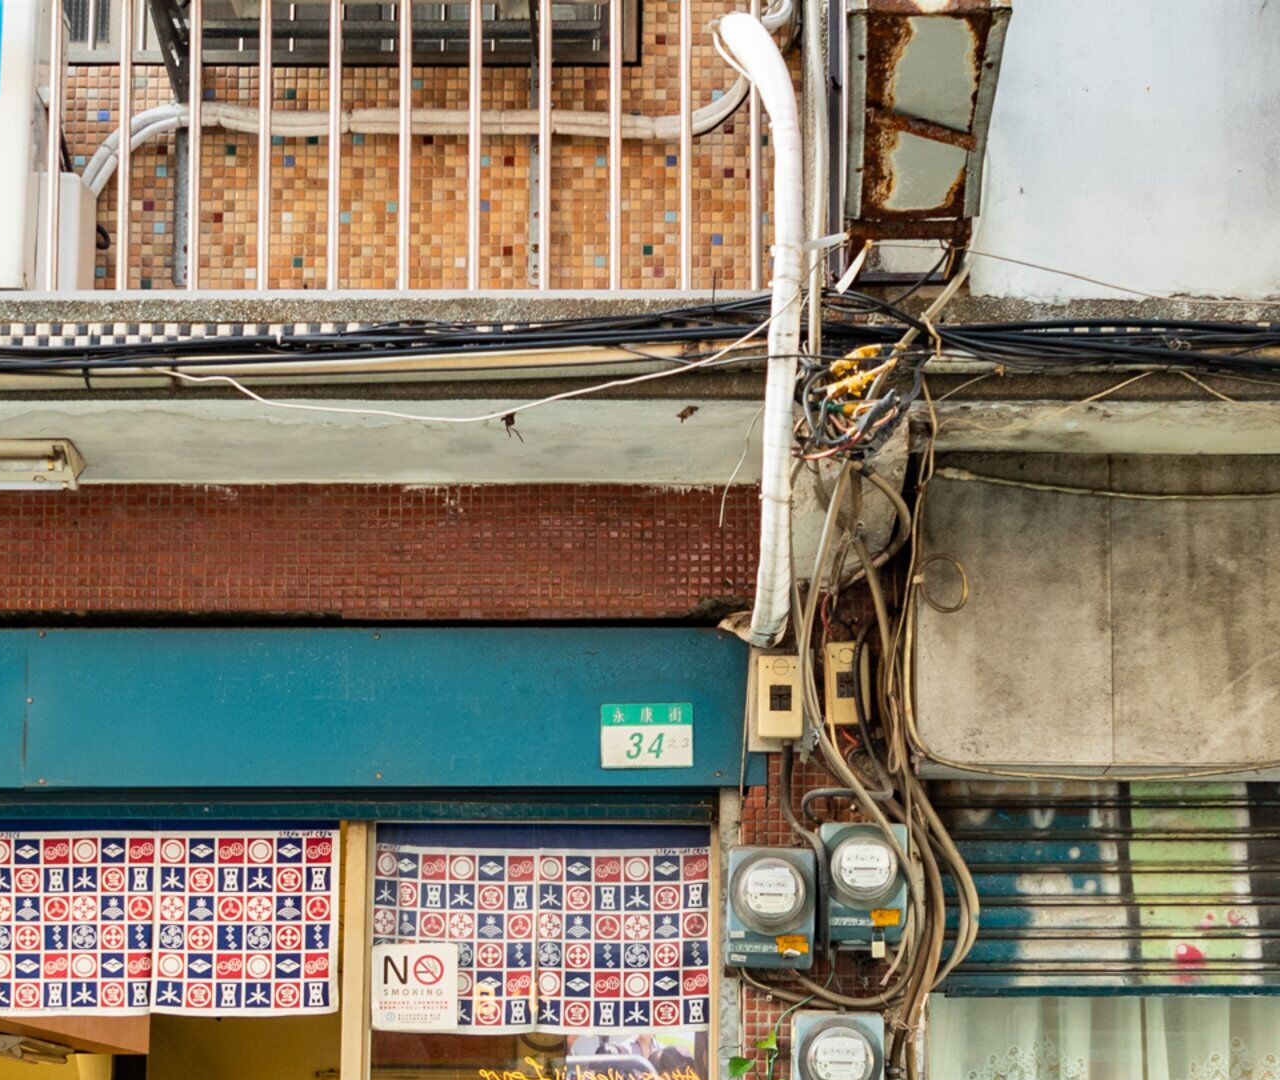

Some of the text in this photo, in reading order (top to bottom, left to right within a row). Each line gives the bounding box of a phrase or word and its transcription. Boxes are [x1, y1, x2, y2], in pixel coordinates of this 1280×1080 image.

[612, 706, 682, 724] 永康街
[625, 731, 665, 760] 34
